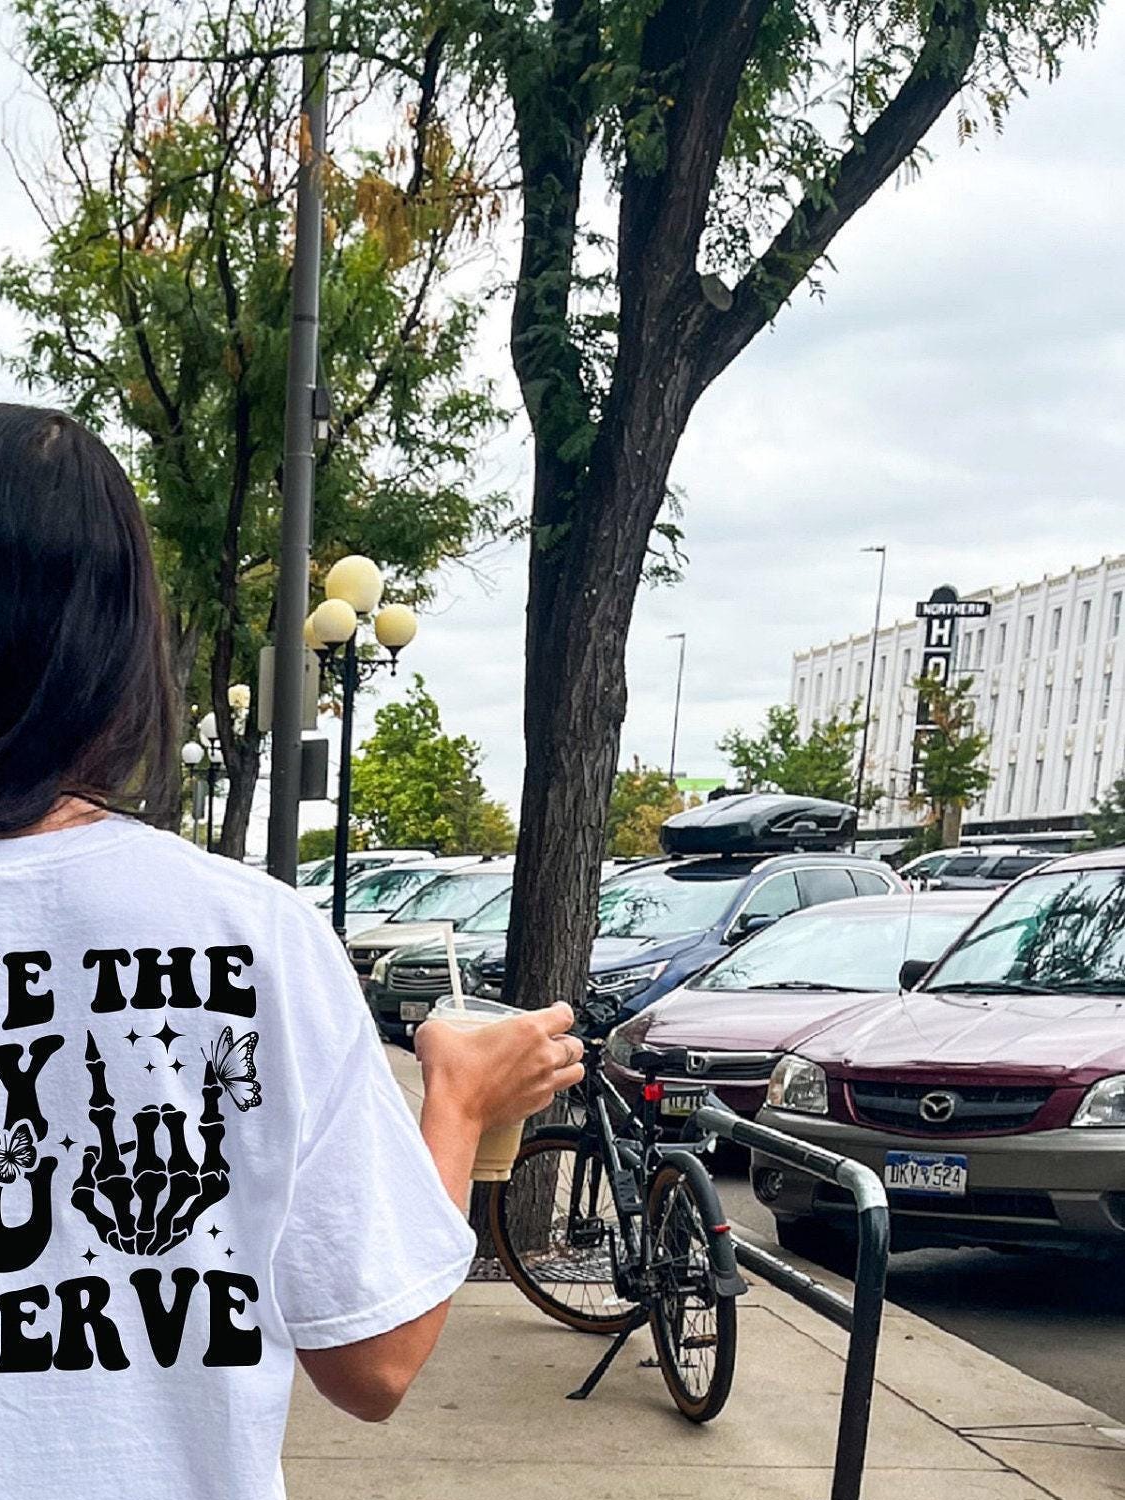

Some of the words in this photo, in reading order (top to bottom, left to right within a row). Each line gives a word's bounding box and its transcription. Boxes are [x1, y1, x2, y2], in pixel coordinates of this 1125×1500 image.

[923, 602, 986, 616] NORTHERN
[82, 944, 257, 1018] THE
[933, 1166, 960, 1188] 524
